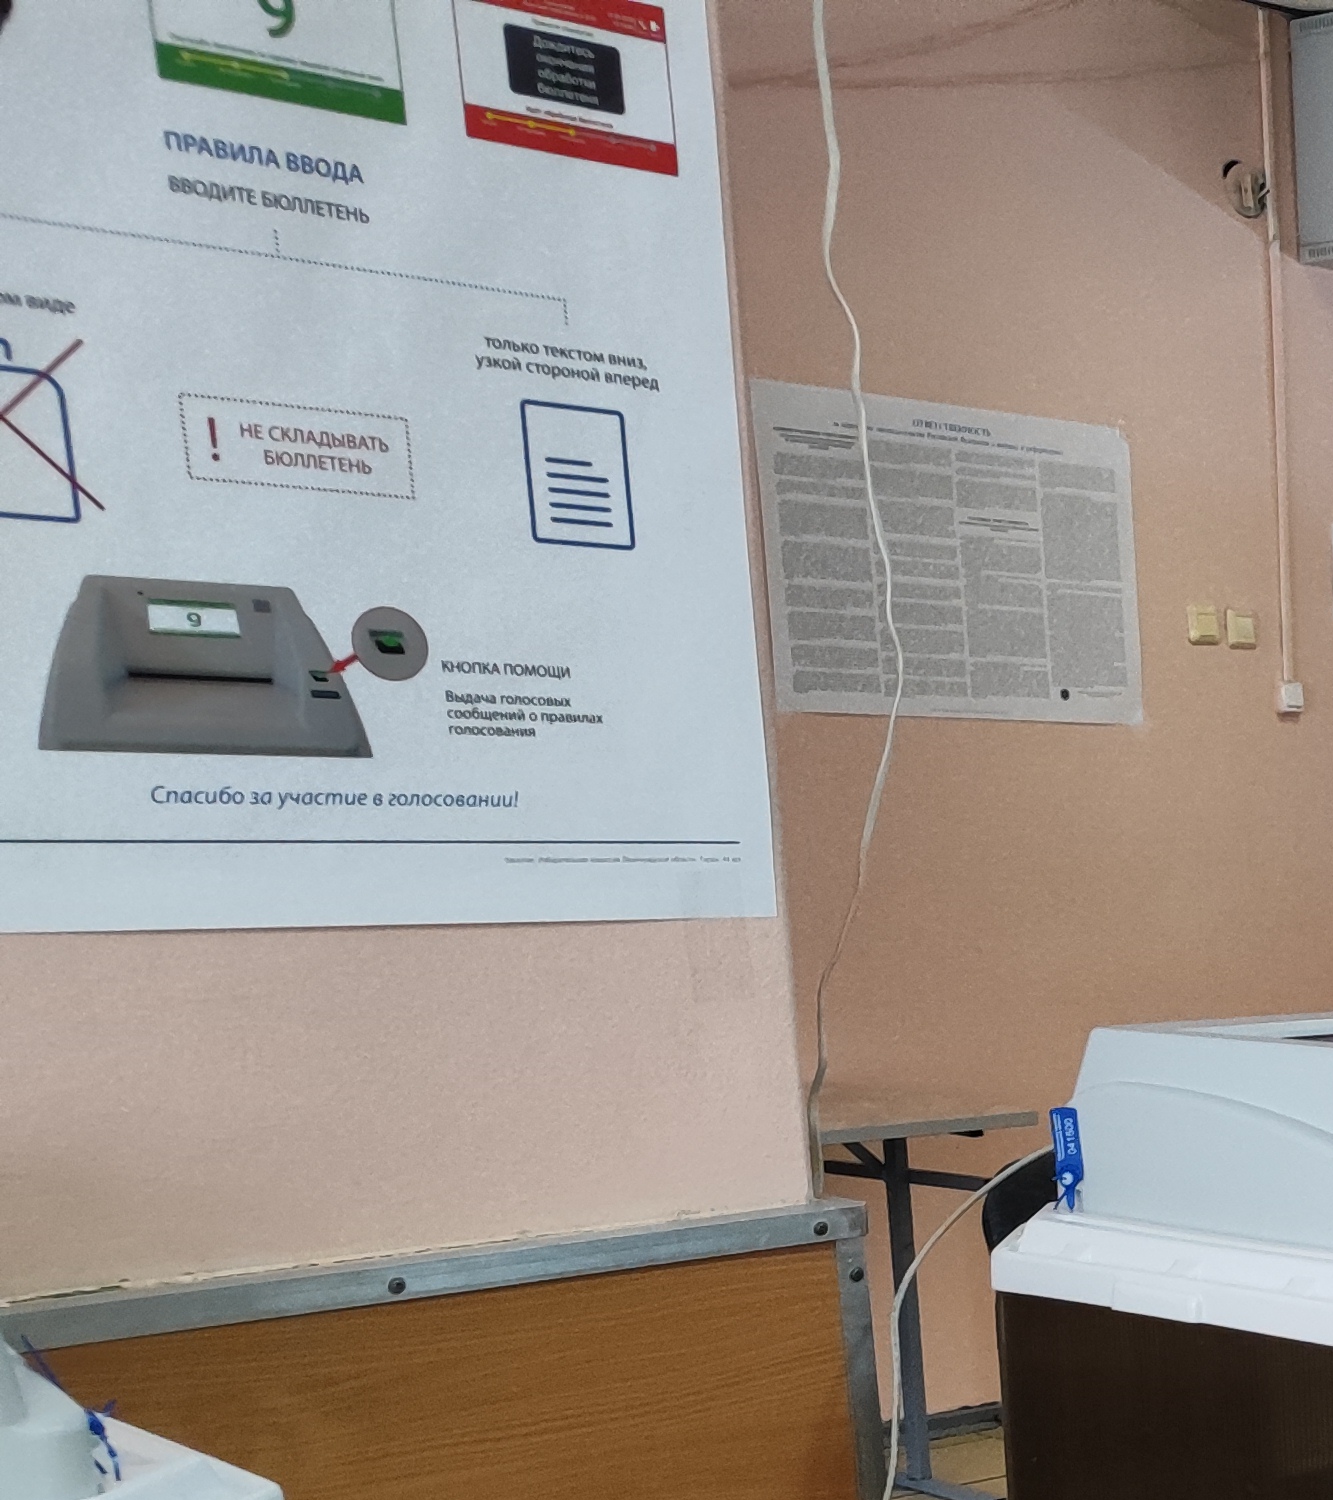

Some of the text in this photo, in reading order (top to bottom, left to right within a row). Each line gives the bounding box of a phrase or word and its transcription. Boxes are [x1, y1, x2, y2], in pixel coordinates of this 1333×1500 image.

[163, 130, 365, 185] ПРАВИЛА ВВОДА
[167, 174, 370, 224] ВВОДИТЕ БЮЛЛЕТЕНЬ
[484, 336, 648, 371] только текстом вниз,
[475, 354, 660, 392] узкой стороной вперед
[239, 422, 390, 453] НЕ СКЛАДЫВАТЬ
[263, 449, 373, 475] БЮЛЛЕТЕНЬ
[441, 660, 571, 680] КНОПКА ПОМОЩИ
[445, 690, 571, 707] Выдача голосовых
[446, 707, 604, 724] сообщений о правилах
[448, 725, 536, 737] голосования
[150, 785, 519, 810] Спасибо за участие в голосовании!
